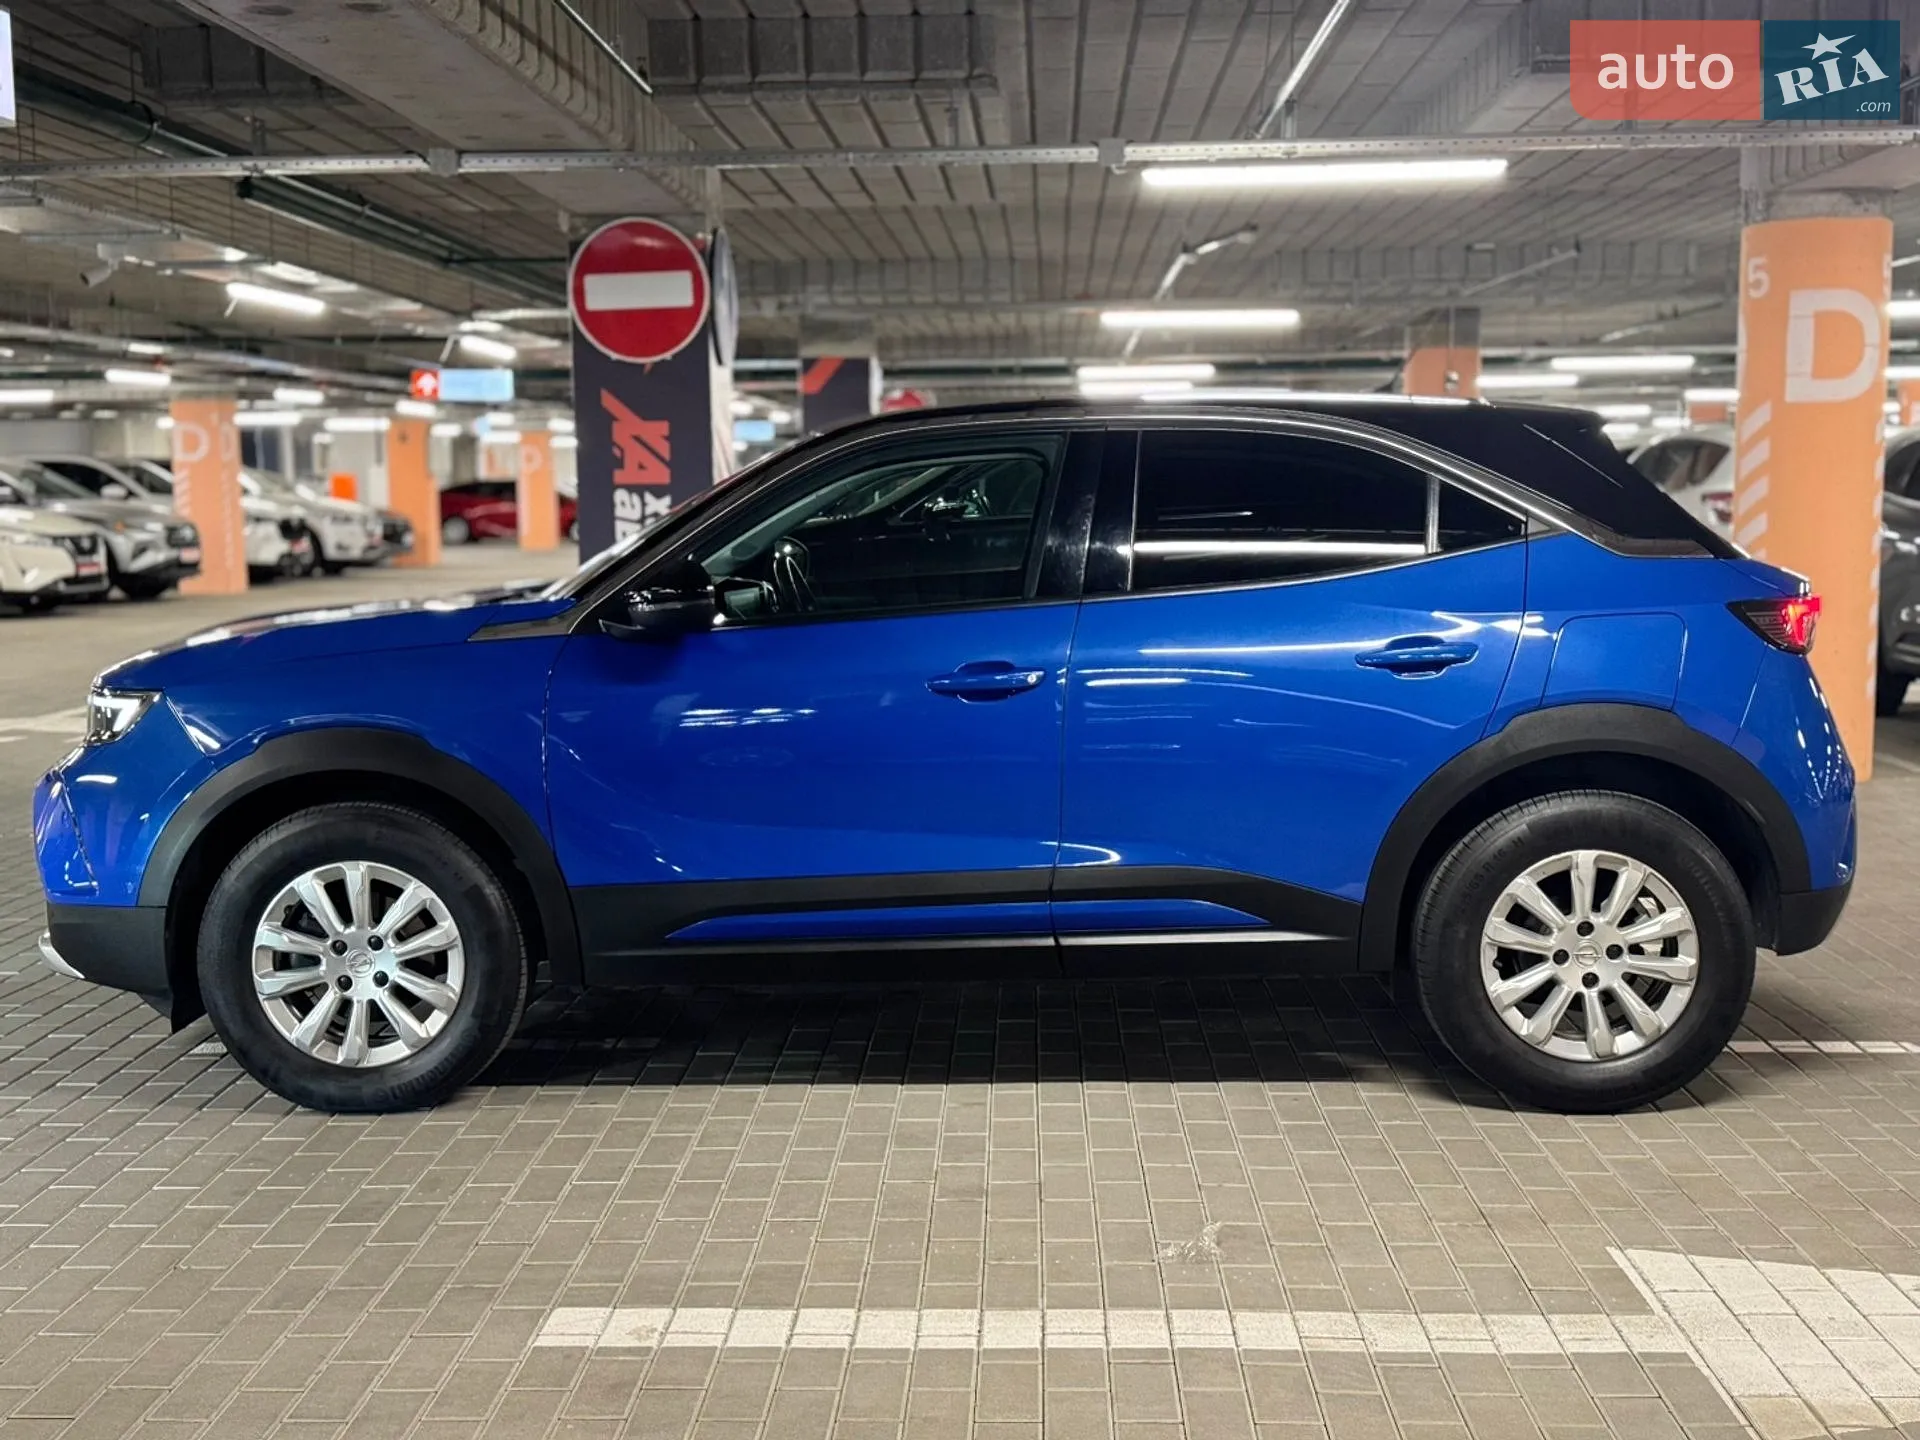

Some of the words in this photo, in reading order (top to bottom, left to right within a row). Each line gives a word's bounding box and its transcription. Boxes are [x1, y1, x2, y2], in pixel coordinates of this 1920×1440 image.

[1748, 256, 1770, 298] 5
[1784, 289, 1881, 404] D
[172, 421, 210, 461] D
